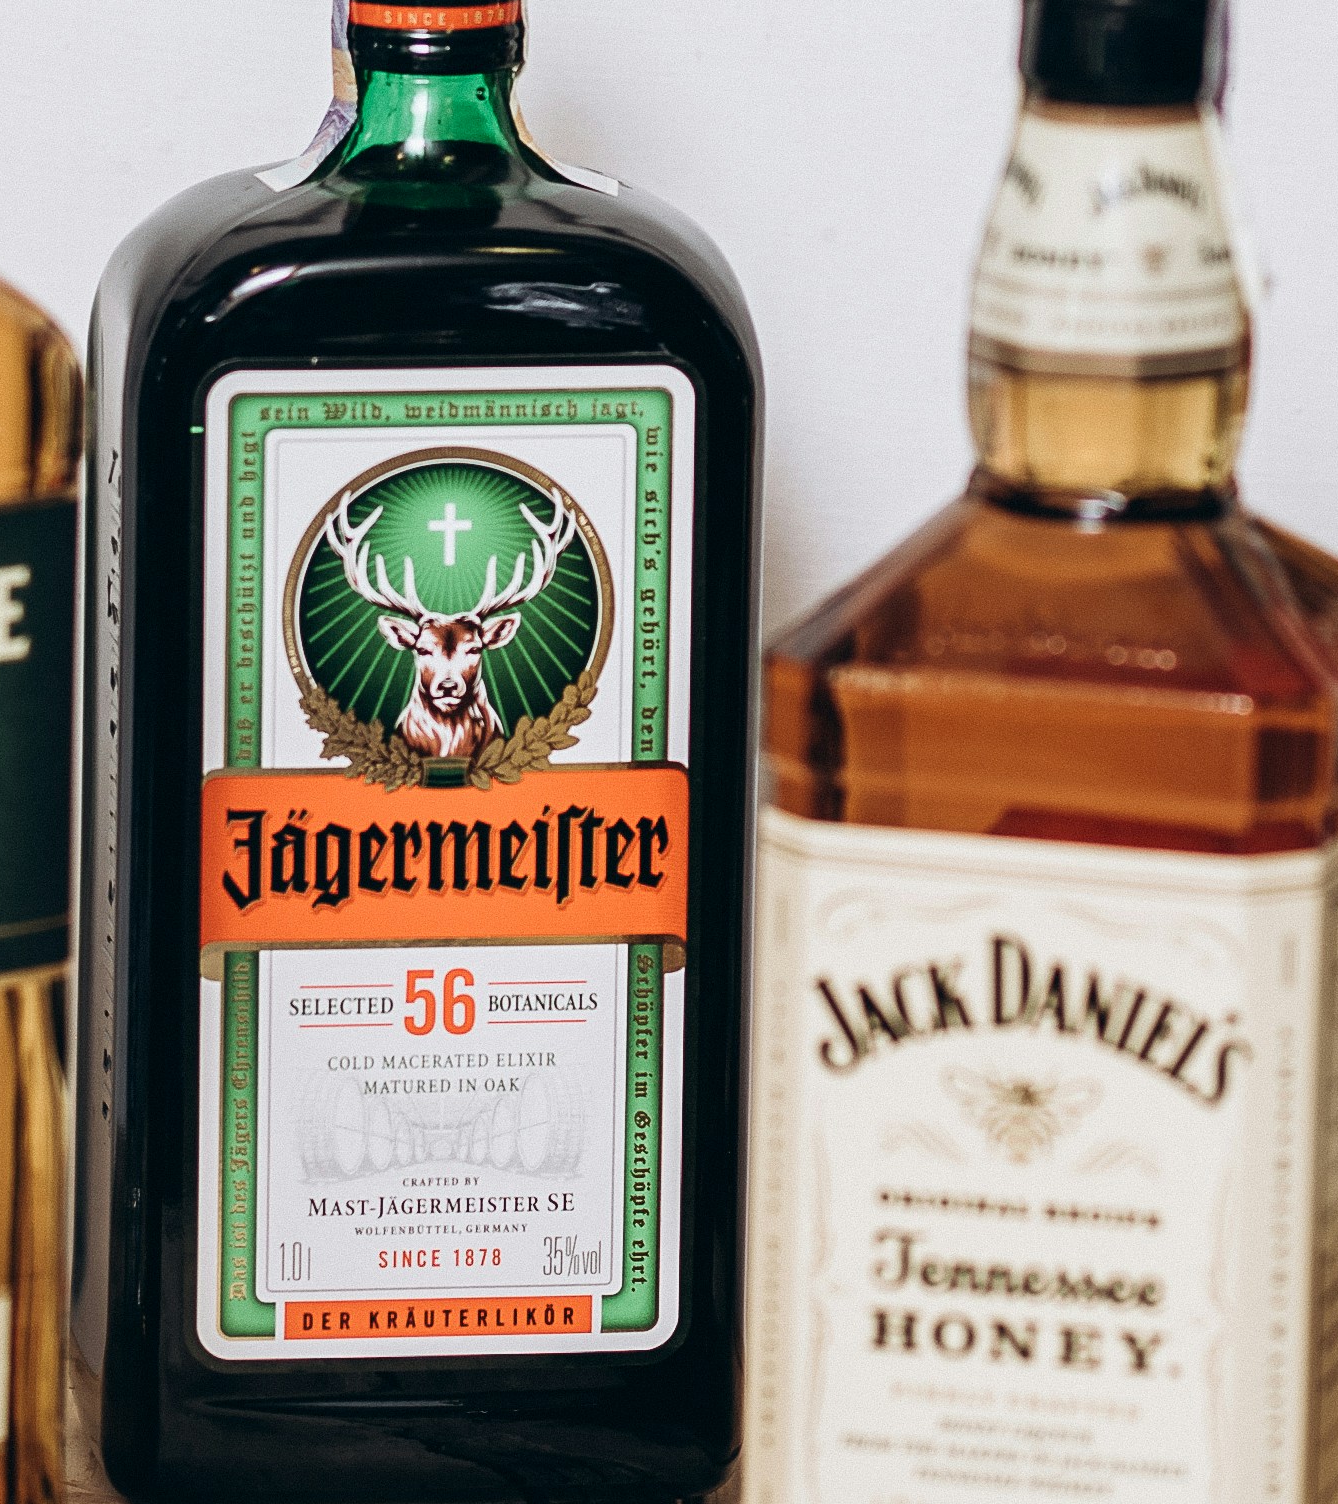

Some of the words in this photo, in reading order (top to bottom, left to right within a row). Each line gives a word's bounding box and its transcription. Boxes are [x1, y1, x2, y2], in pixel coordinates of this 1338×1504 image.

[383, 10, 447, 26] SINCE
[260, 404, 311, 422] sein
[289, 996, 395, 1016] SELECTED
[403, 968, 477, 1036] 56
[488, 992, 599, 1012] BOTANICALS
[815, 955, 976, 1074] JACK
[991, 929, 1255, 1111] DANIEL'S
[327, 1055, 375, 1071] COLD
[381, 1053, 490, 1070] MACERATED
[496, 1051, 557, 1068] ELIXIR
[364, 1078, 452, 1095] MATURED
[458, 1078, 478, 1093] IN
[484, 1077, 521, 1092] OAK
[402, 1177, 459, 1188] CRAFTED
[464, 1176, 481, 1186] BY
[308, 1195, 541, 1219] MAST-JÄGERMEISTER
[547, 1192, 576, 1212] SE
[465, 1223, 528, 1234] GERMANY
[378, 1249, 441, 1268] SINCE
[453, 1247, 503, 1267] 1878
[872, 1227, 1167, 1309] Tennessee
[302, 1312, 352, 1331] DER
[368, 1303, 575, 1330] KRÄUTERLIKÖR
